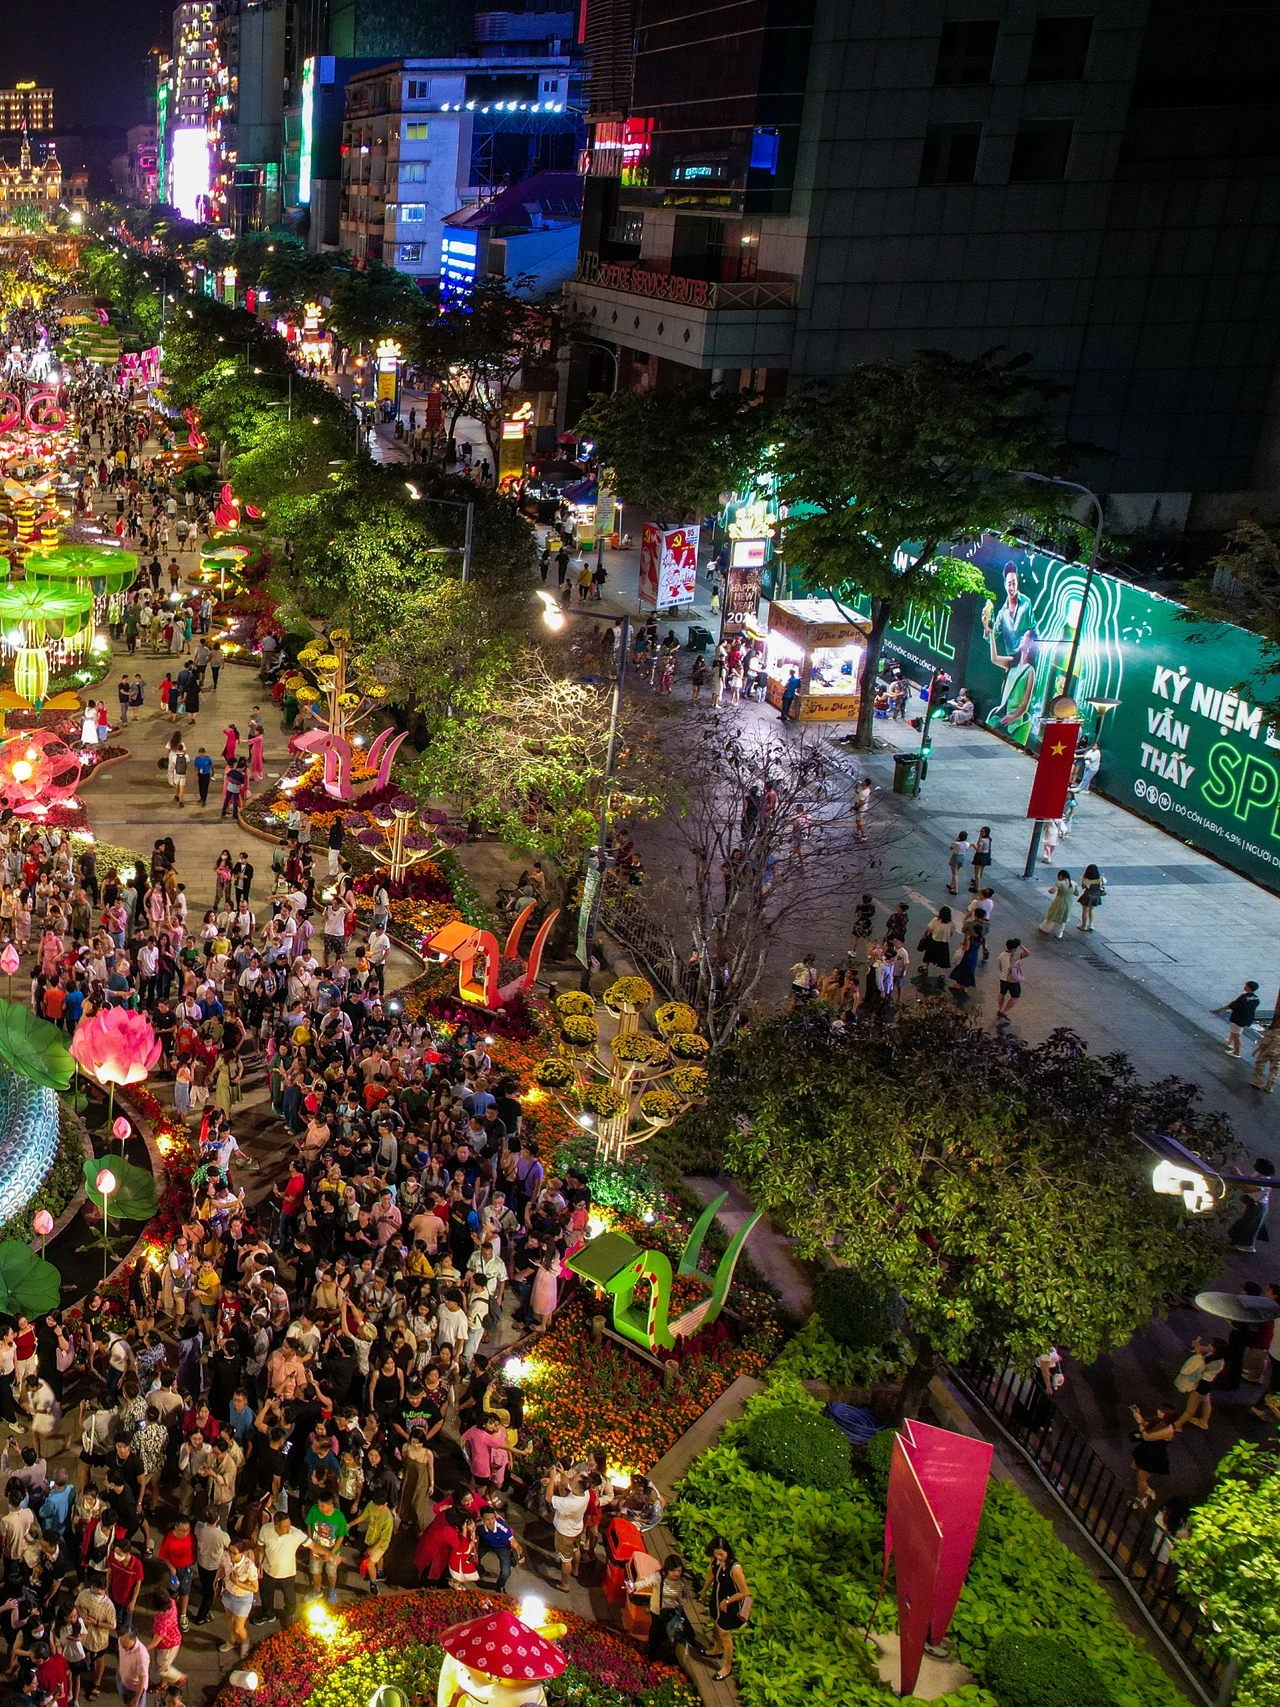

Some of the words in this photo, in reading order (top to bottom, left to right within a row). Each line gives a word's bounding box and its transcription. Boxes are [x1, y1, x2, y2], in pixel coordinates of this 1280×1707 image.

[601, 265, 631, 288] OFFICE
[631, 270, 668, 296] SERVICE
[670, 275, 708, 303] CENTER
[733, 601, 754, 610] YEAR
[734, 592, 755, 601] NEW
[810, 704, 829, 714] The
[1152, 665, 1192, 705] KỶ
[1190, 682, 1263, 739] NIỆM
[1148, 707, 1190, 750] VẪN
[1141, 742, 1196, 789] THẤY
[1201, 742, 1280, 839] SP
[1175, 804, 1186, 817] ĐỘ
[1203, 818, 1224, 837] (ABV):
[1246, 842, 1271, 863] NGƯỜI
